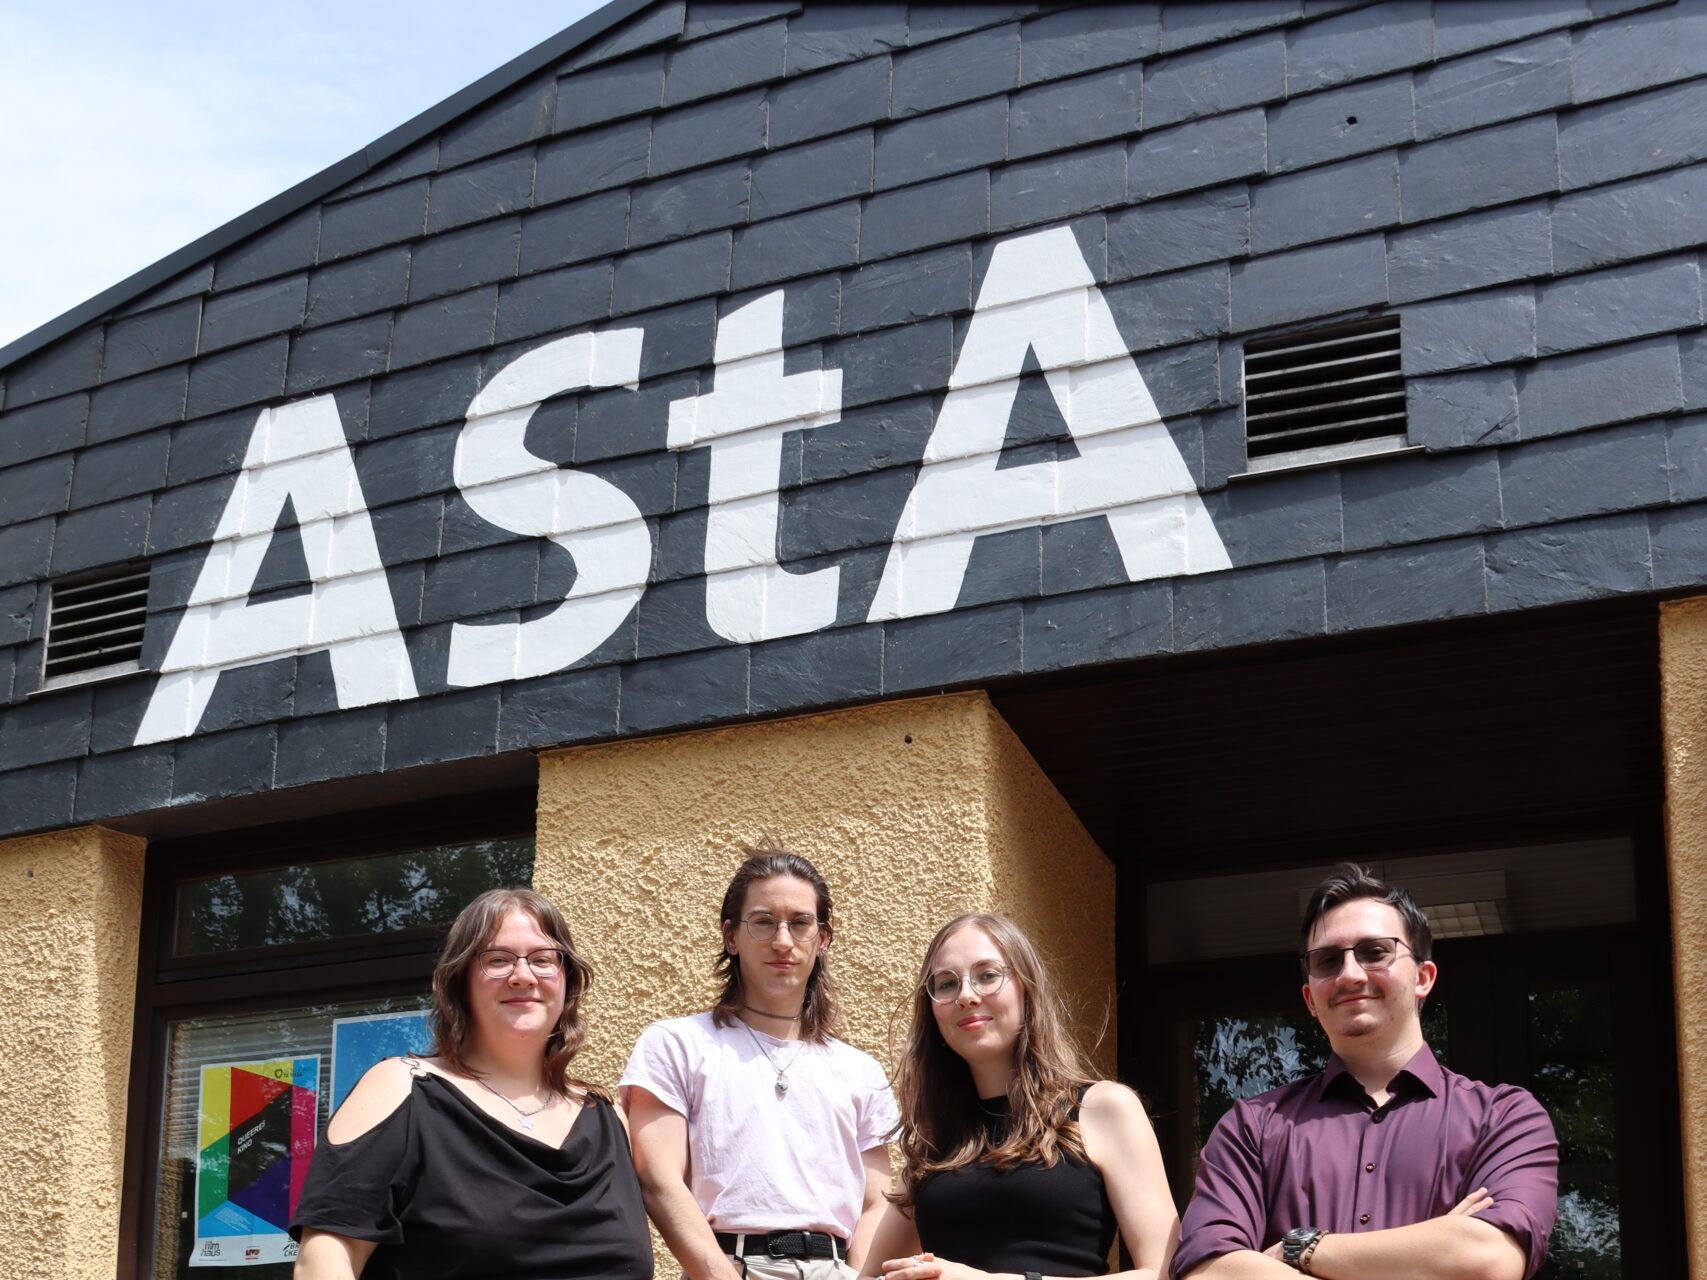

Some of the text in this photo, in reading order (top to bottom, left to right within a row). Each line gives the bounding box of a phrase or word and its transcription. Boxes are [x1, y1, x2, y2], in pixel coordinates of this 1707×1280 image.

[133, 224, 1233, 746] AStA
[237, 1119, 266, 1145] QUEERES
[237, 1138, 253, 1155] KINO
